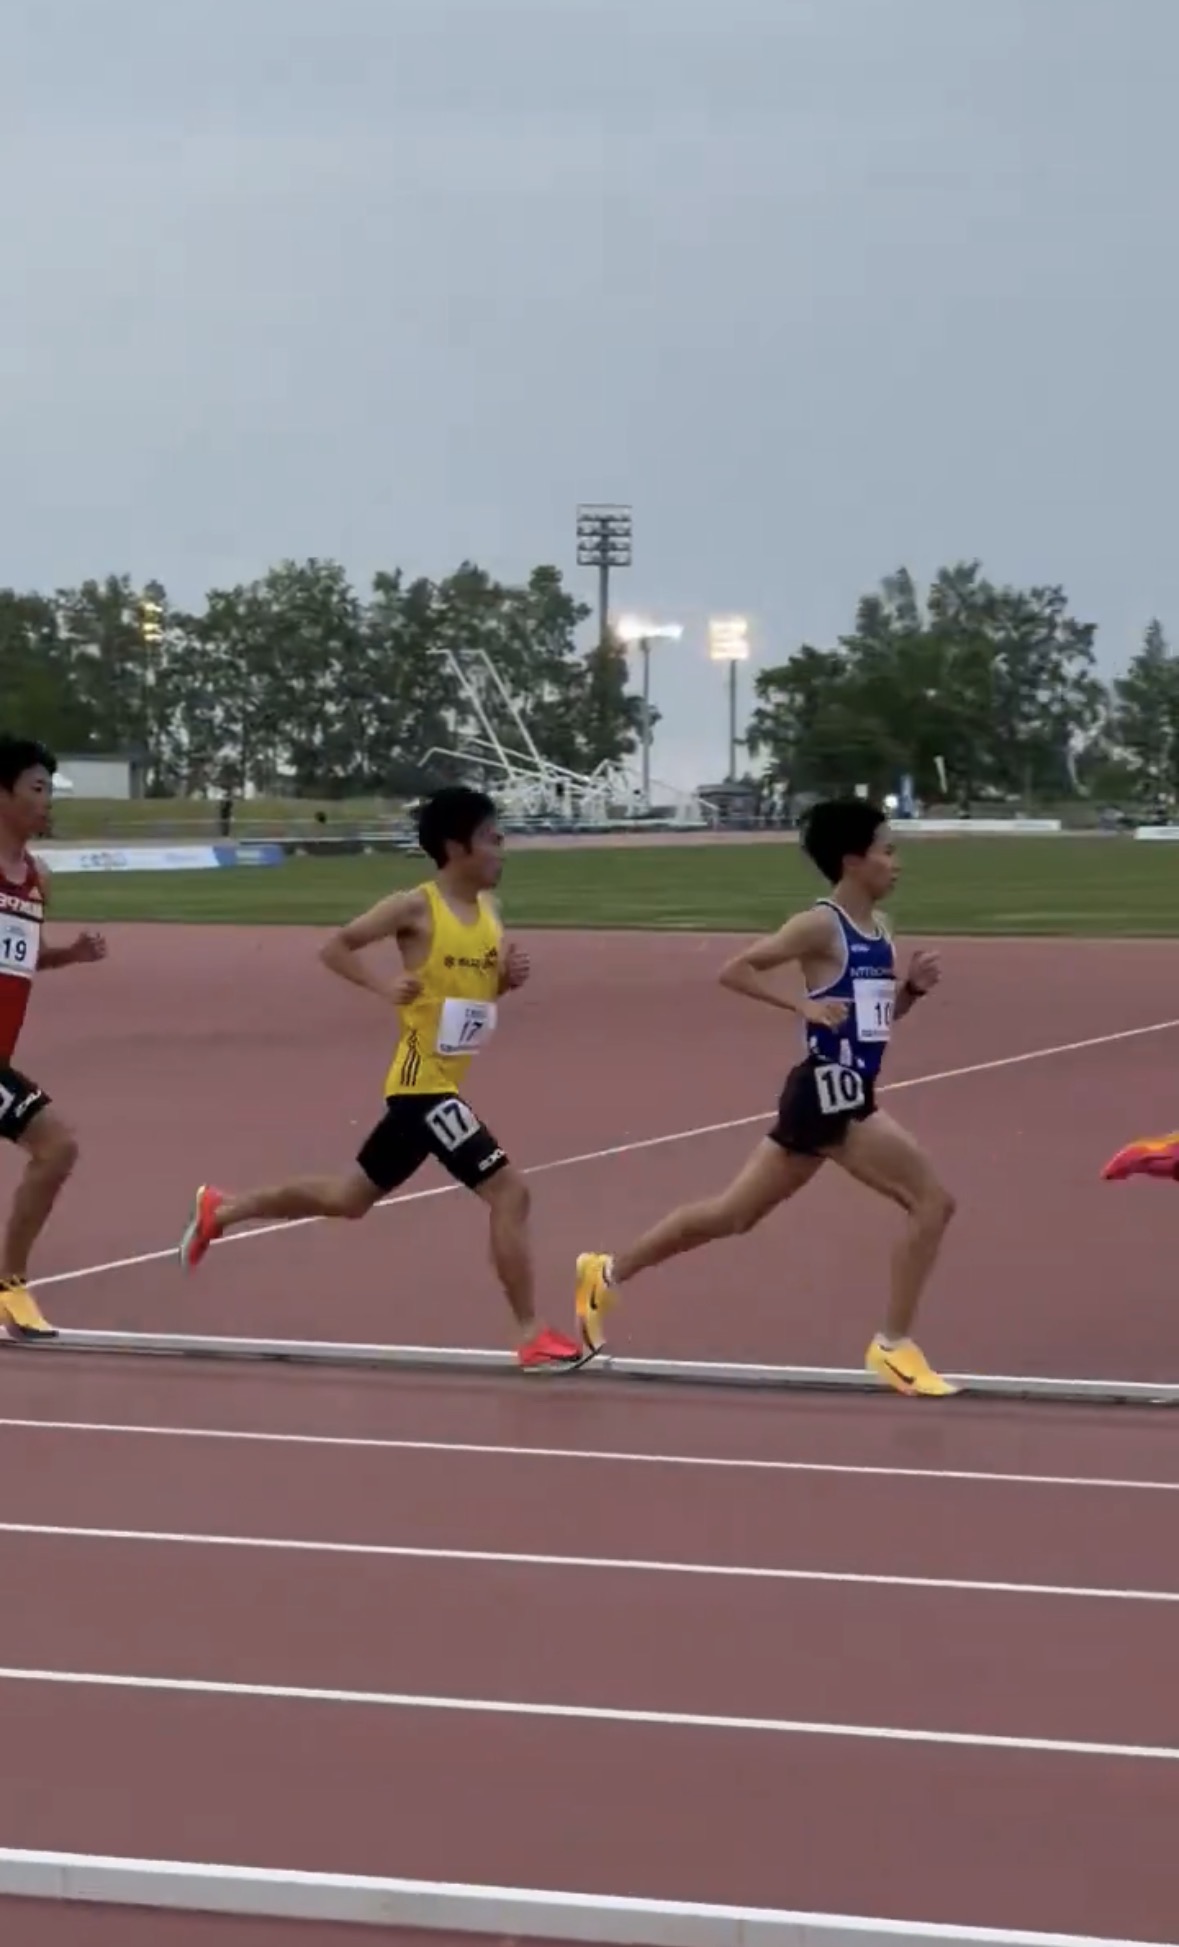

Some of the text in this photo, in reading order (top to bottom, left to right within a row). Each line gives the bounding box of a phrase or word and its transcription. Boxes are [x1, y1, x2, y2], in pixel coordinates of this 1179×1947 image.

[2, 937, 27, 962] 19
[458, 1020, 484, 1042] 17
[821, 1069, 858, 1107] 10
[432, 1102, 469, 1142] 17
